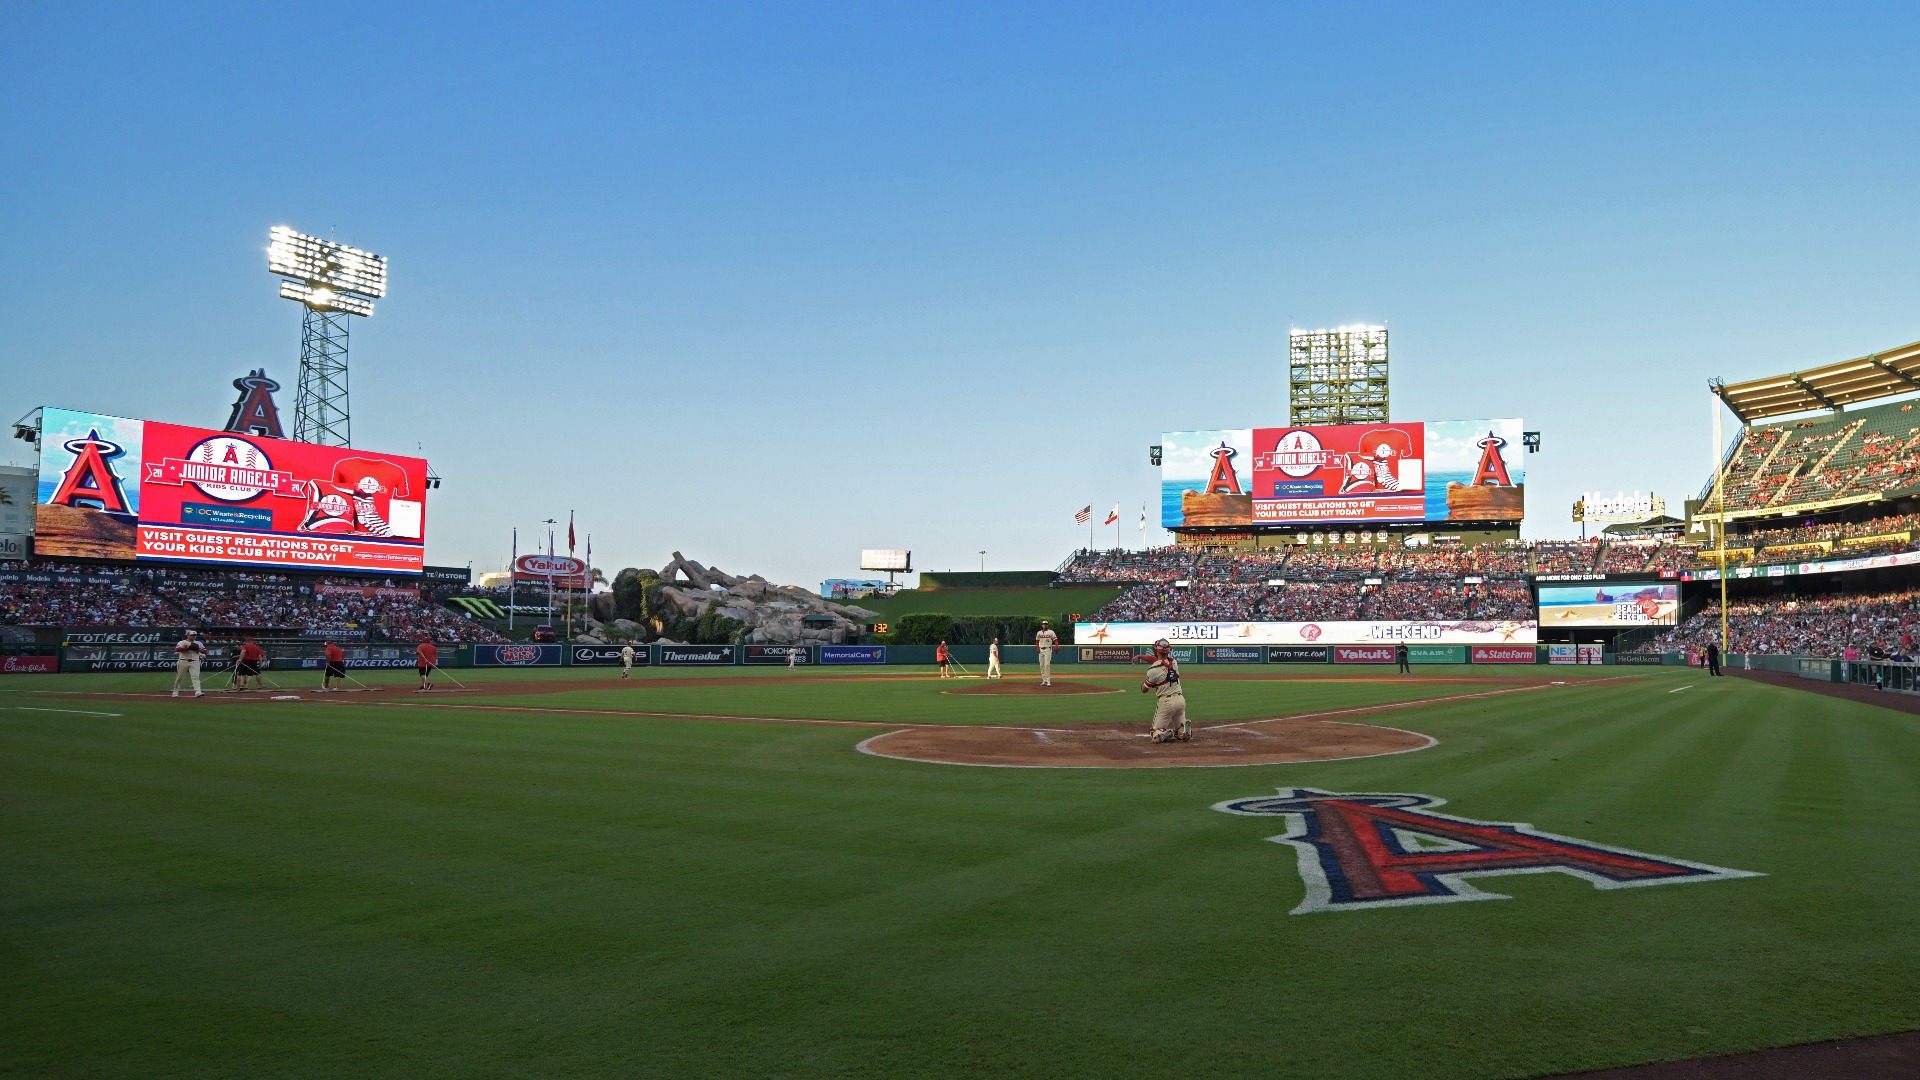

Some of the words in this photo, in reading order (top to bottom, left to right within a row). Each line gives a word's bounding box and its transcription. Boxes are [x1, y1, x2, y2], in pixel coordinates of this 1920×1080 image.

[1271, 453, 1298, 465] JUNIOR
[1298, 452, 1327, 464] ANGELS
[153, 468, 163, 478] 20
[179, 463, 226, 483] JUNIOR
[230, 468, 279, 489] ANGELS
[229, 485, 251, 493] CLUB
[291, 483, 300, 492] 24
[1302, 502, 1347, 510] RELATIONS
[1583, 490, 1652, 515] Modelo
[1335, 508, 1365, 516] TODAY!
[143, 530, 183, 542] VISIT
[186, 533, 232, 545] GUEST
[235, 538, 309, 551] RELATIONS
[311, 542, 328, 552] TO
[330, 544, 354, 553] GET
[143, 541, 186, 553] YOUR
[189, 544, 224, 555] KIDS
[227, 547, 263, 557] CLUB
[266, 549, 288, 559] KIT
[290, 551, 336, 562] TODAY!
[528, 559, 576, 572] Yakult
[1616, 604, 1643, 614] BEACH
[1168, 625, 1219, 640] BEACH
[1371, 625, 1442, 639] WEEKEND
[501, 645, 536, 653] Jersey
[504, 652, 535, 662] Mike's
[663, 652, 721, 661] Thermador
[1338, 650, 1392, 660] Yakult
[1617, 655, 1660, 663] HeGetsUs.com
[91, 661, 126, 669] NITTO
